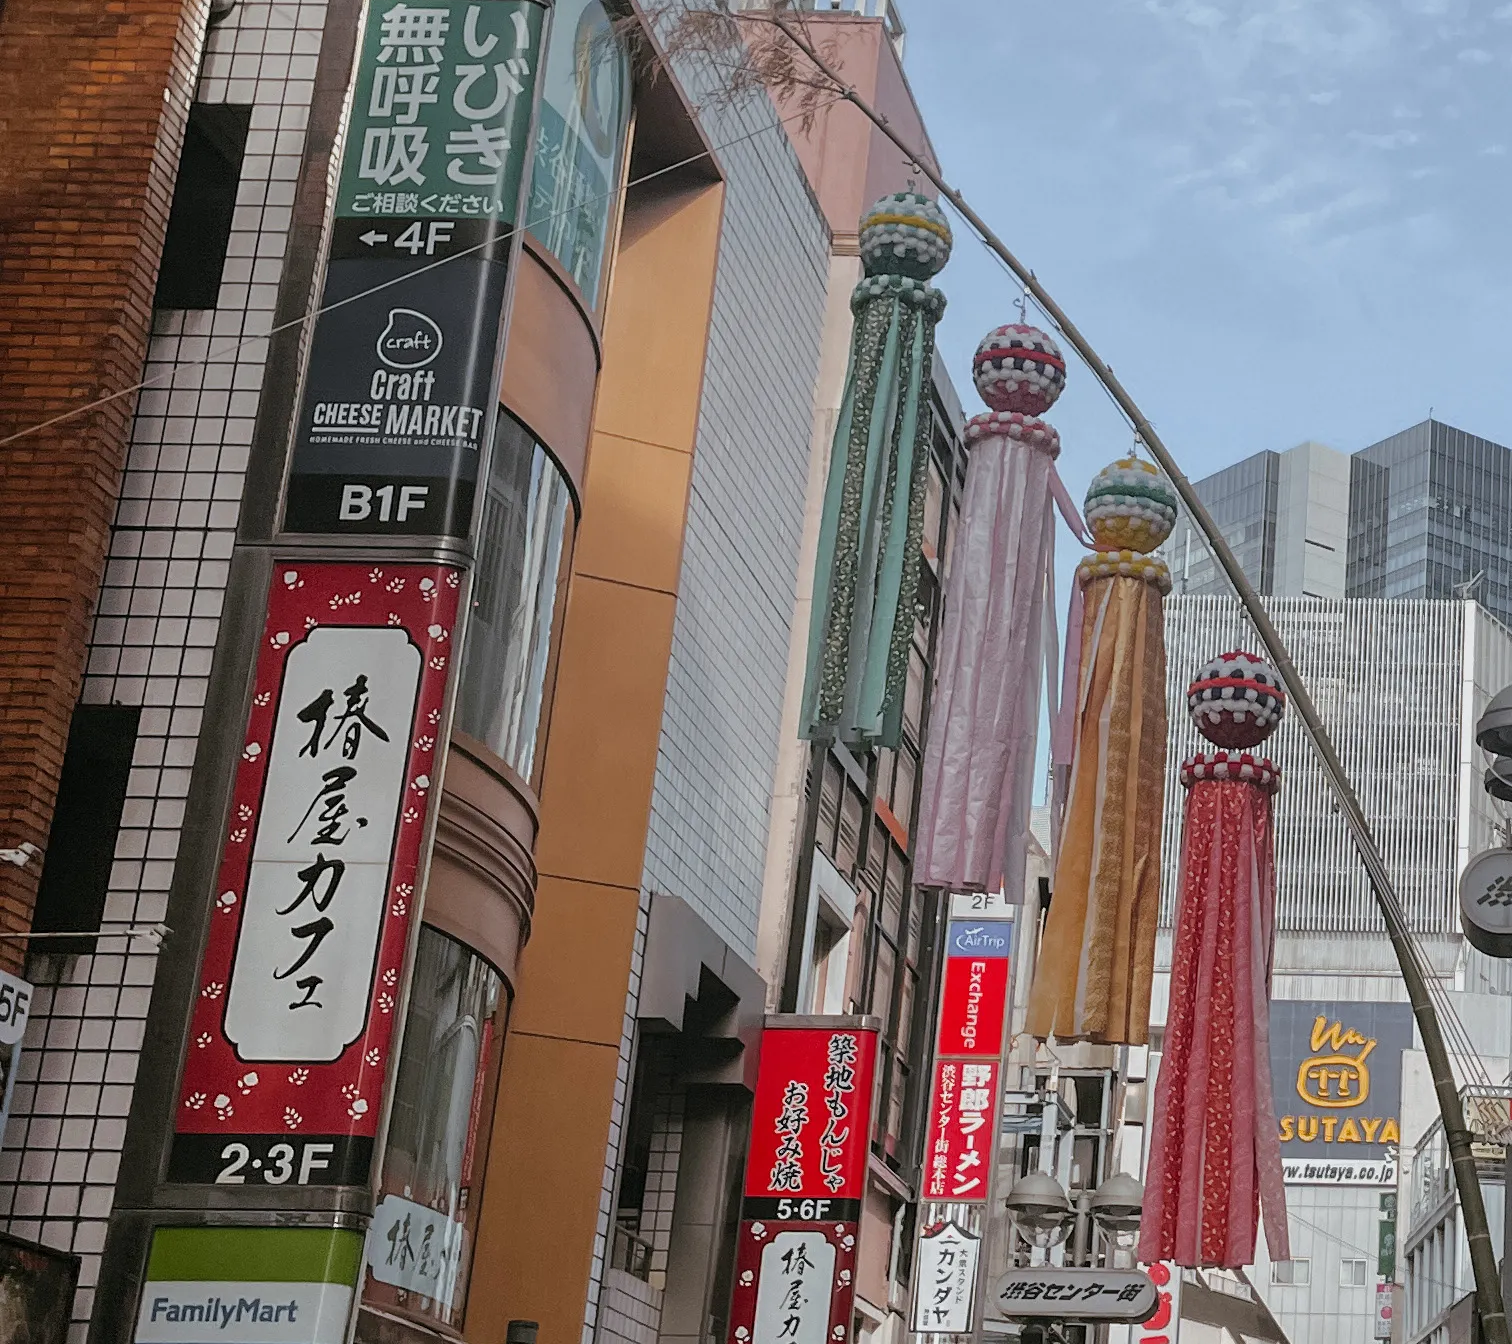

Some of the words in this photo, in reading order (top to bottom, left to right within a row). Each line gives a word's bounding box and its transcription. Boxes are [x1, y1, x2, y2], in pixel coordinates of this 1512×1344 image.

[359, 3, 449, 186] 無呼吸
[443, 6, 530, 186] いびき
[349, 192, 504, 217] ご相談ください
[394, 221, 453, 257] 4F
[370, 369, 435, 401] Craft
[313, 403, 383, 425] CHEESE
[385, 405, 483, 440] MARKET
[339, 484, 429, 523] B1F
[276, 675, 389, 1011] 椿屋カフェ
[964, 932, 1004, 949] AirTrip
[960, 961, 985, 1049] Exchange
[819, 1033, 857, 1192] 築地もんじゃ
[952, 1064, 991, 1196] 野郎ラーメン
[1280, 1117, 1399, 1143] SUTAYA
[768, 1081, 809, 1192] お好み焼
[1283, 1165, 1394, 1183] w.tsutaya.co.jp
[386, 1212, 456, 1284] 椿屋
[933, 1249, 957, 1325] カンダヤ
[1000, 1282, 1146, 1302] 渋谷センター街
[150, 1296, 298, 1325] FamilyMart
